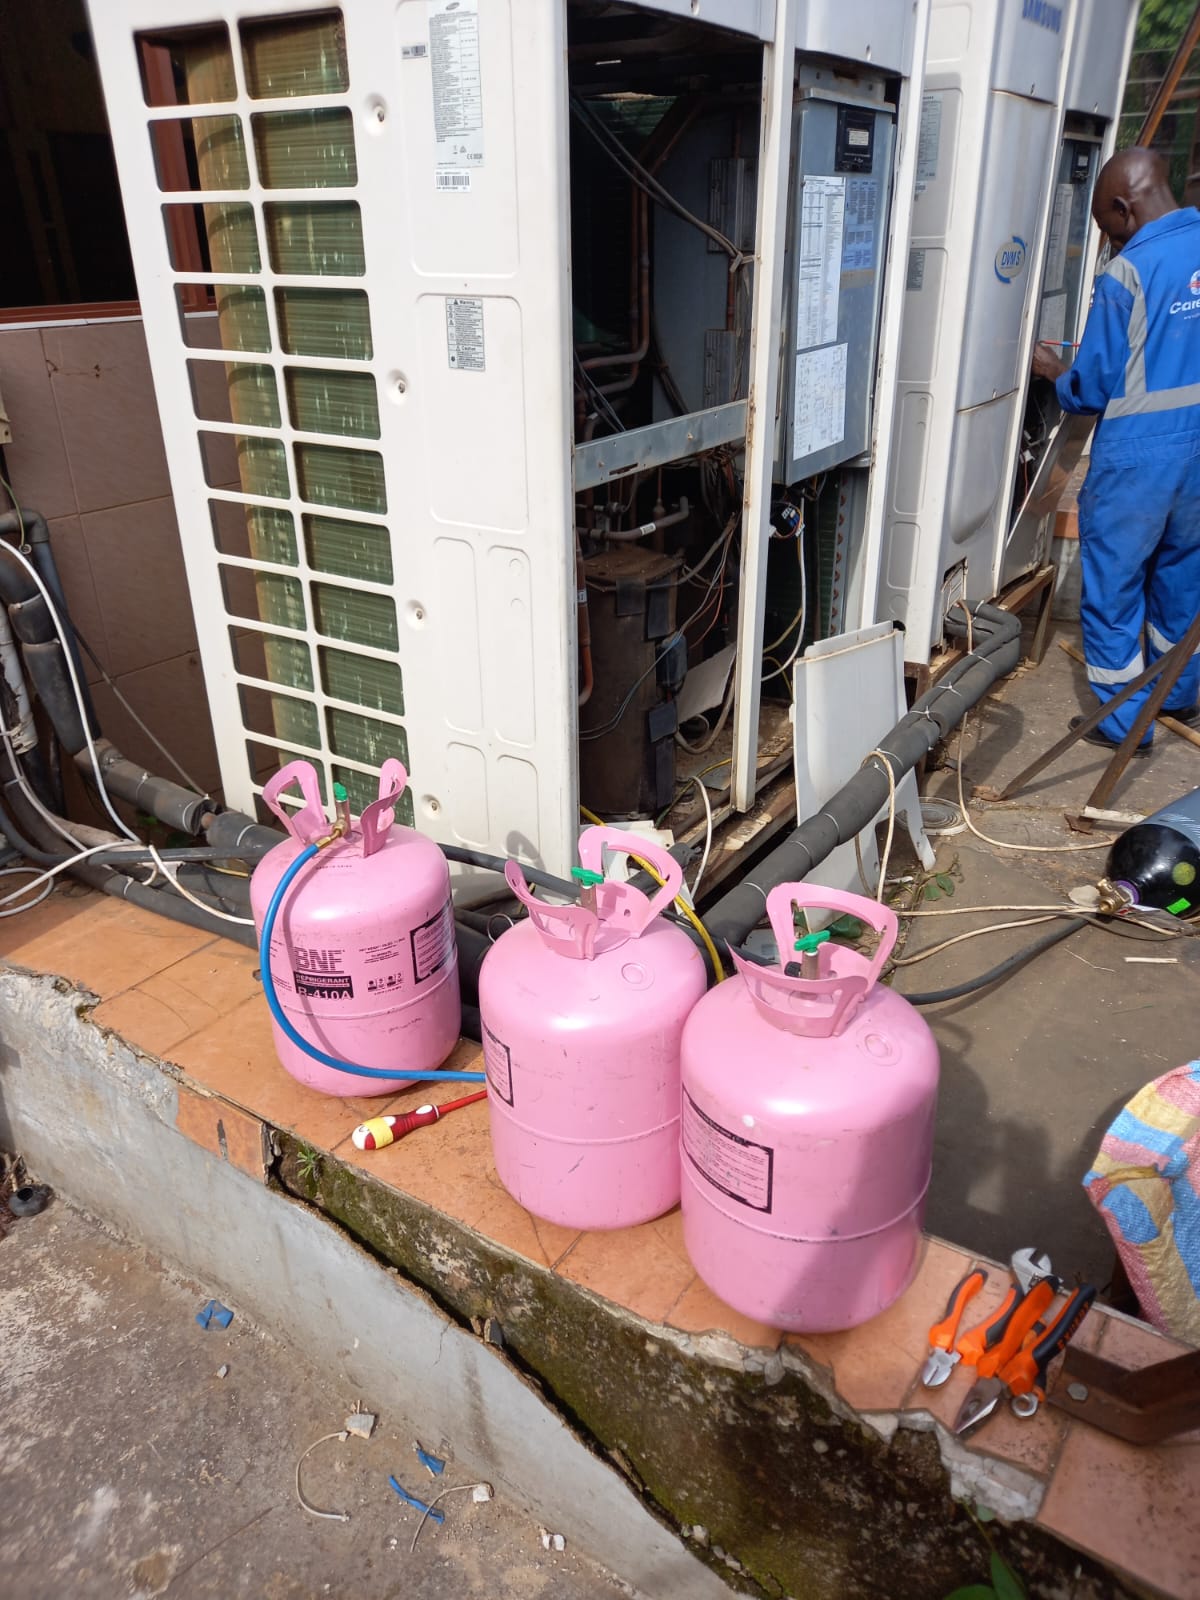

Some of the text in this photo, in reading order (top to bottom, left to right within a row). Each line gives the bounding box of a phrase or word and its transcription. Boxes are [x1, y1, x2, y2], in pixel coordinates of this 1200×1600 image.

[294, 947, 342, 970] BNF
[296, 974, 349, 984] REFRIGERANT
[298, 986, 352, 1000] R-410A
